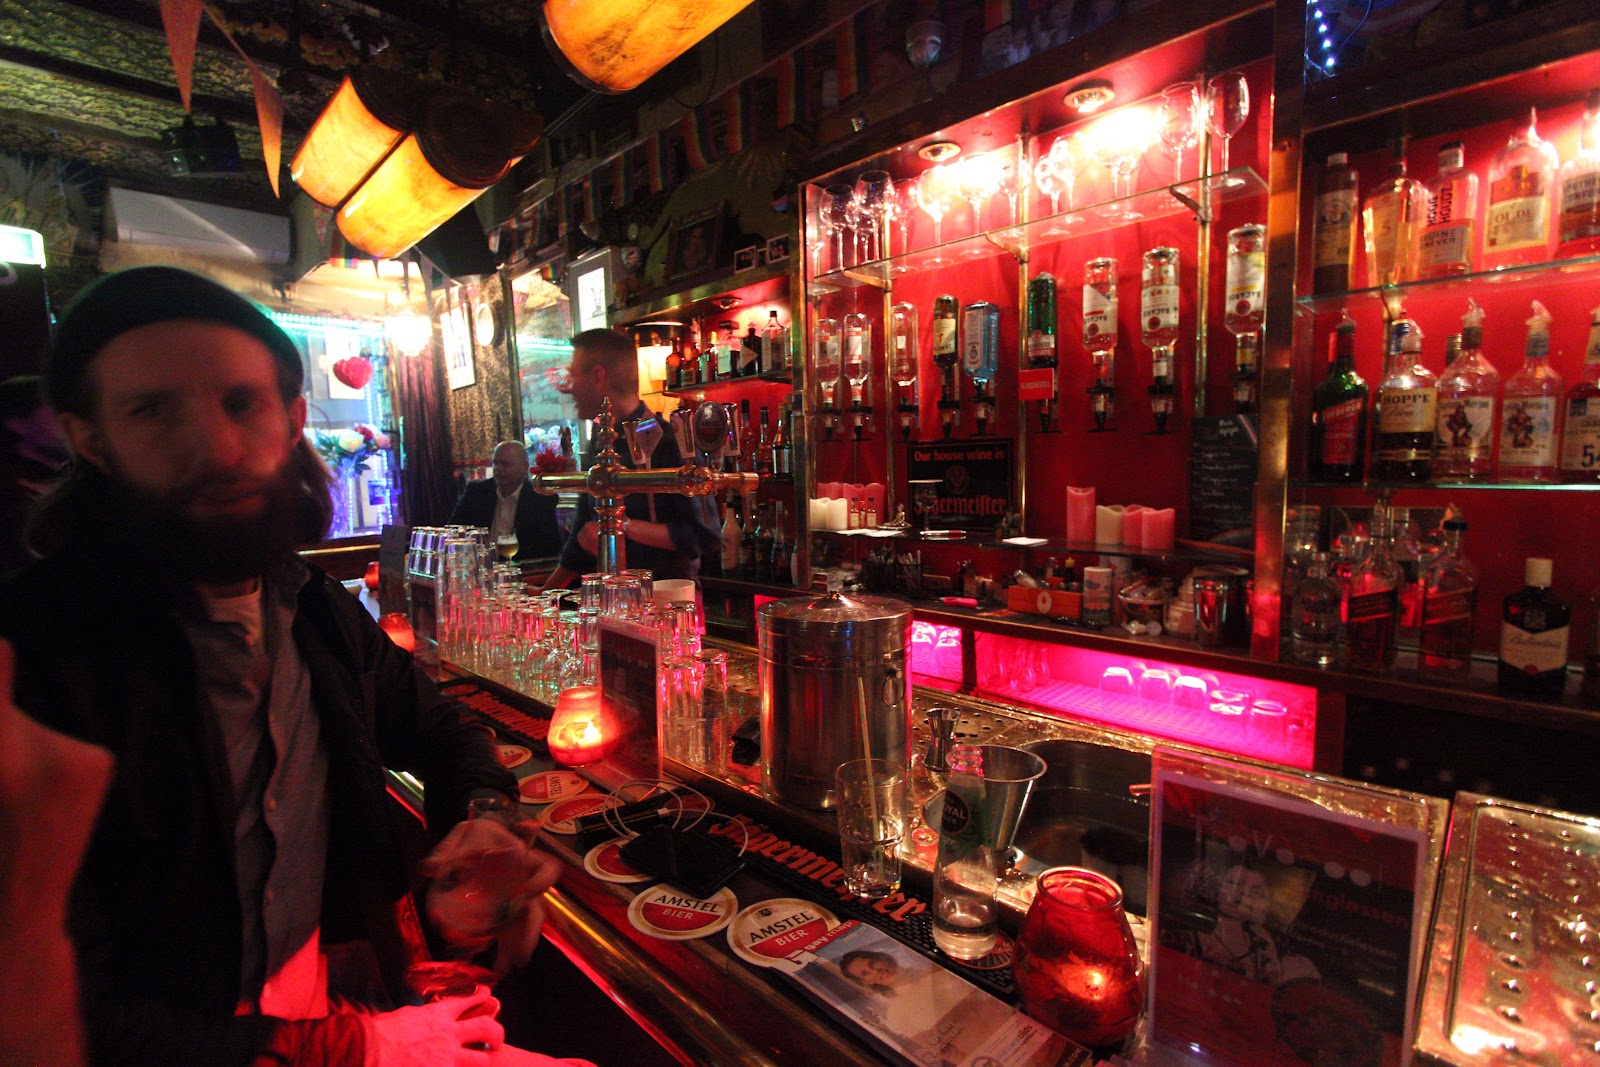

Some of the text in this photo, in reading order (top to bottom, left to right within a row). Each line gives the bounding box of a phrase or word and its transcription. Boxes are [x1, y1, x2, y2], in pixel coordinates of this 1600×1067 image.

[1383, 394, 1430, 404] HOPPE
[914, 447, 1005, 462] Our house wine is
[654, 893, 718, 914] AMSTEL
[662, 907, 694, 921] BIER
[750, 911, 814, 943] AMSTEL
[804, 936, 829, 951] gay
[826, 921, 853, 937] map
[775, 928, 808, 947] BIER
